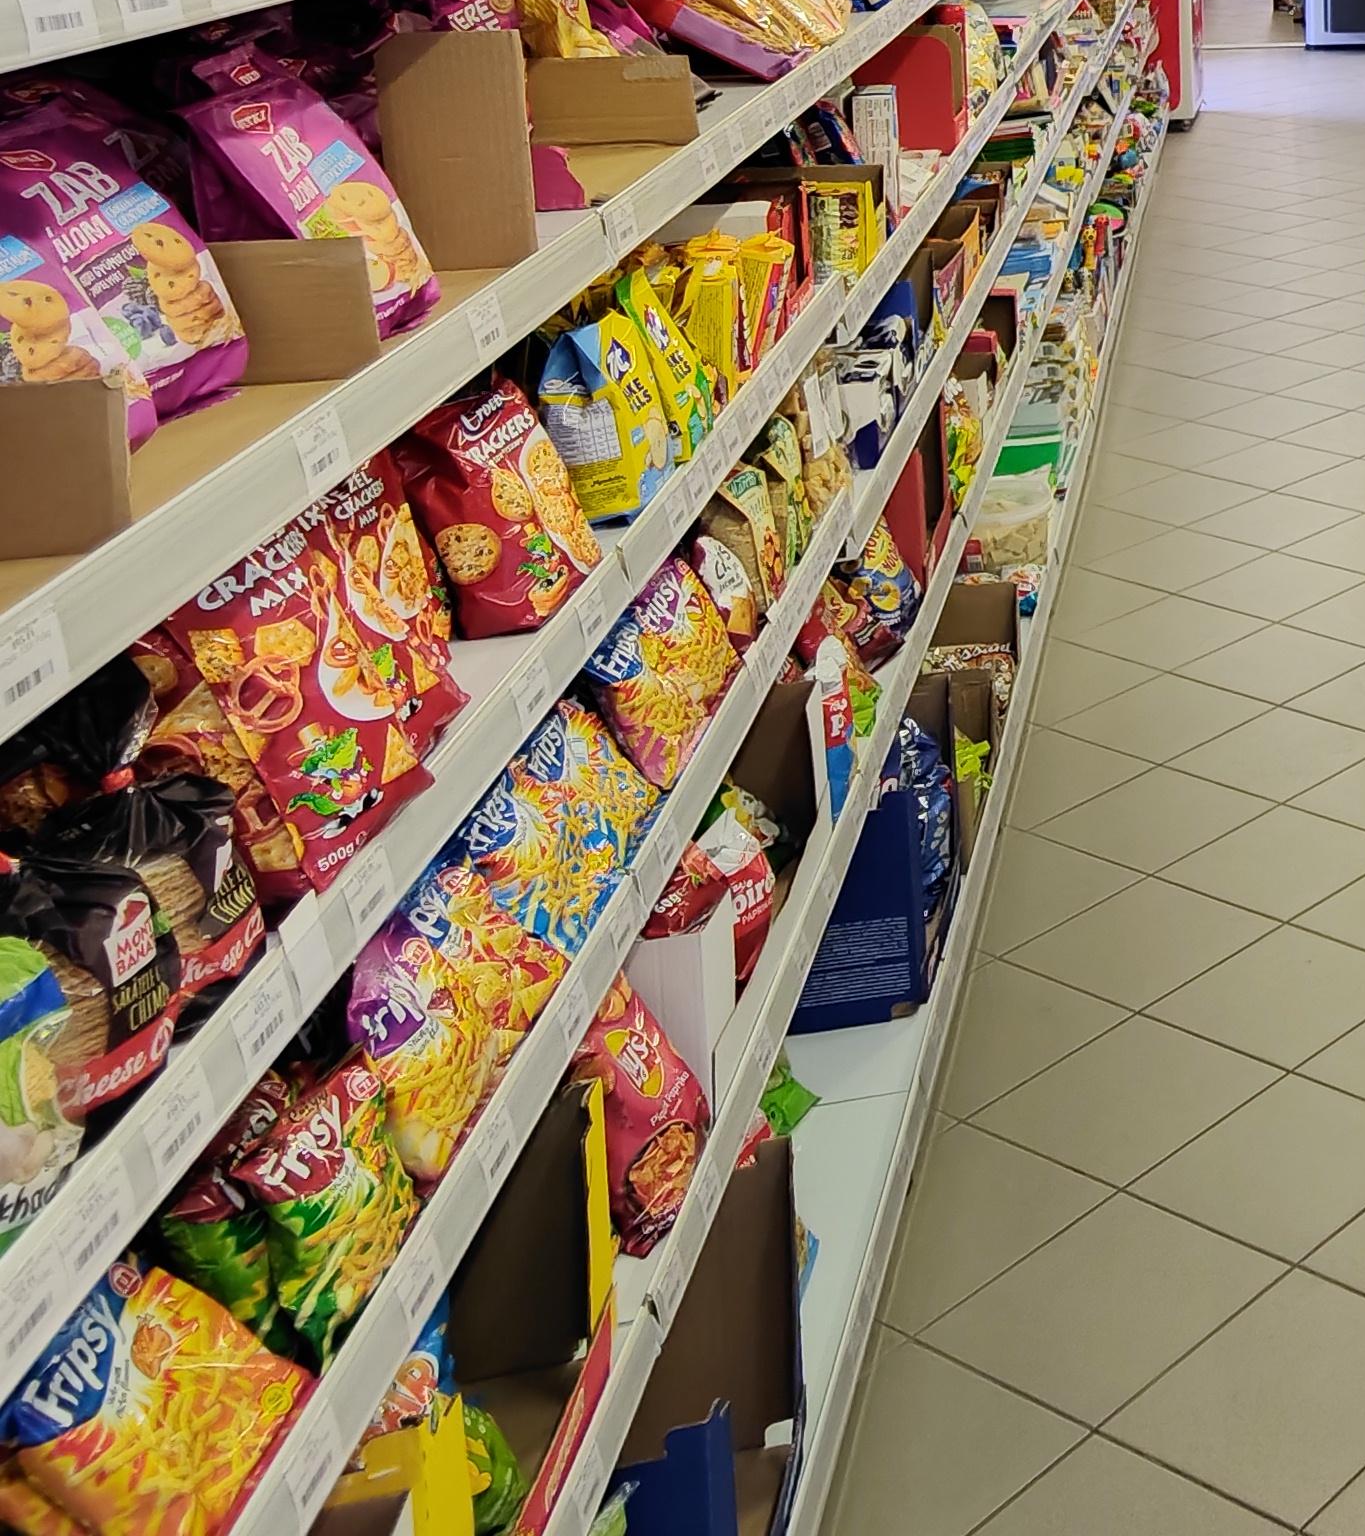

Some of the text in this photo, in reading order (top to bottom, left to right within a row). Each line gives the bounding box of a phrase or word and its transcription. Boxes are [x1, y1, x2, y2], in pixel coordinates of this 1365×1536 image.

[20, 160, 121, 227] ZAB
[358, 505, 379, 530] MIX
[249, 568, 310, 617] MIX
[596, 625, 643, 687] Fripsy
[317, 842, 355, 874] 500g
[20, 1292, 128, 1429] Fripsy
